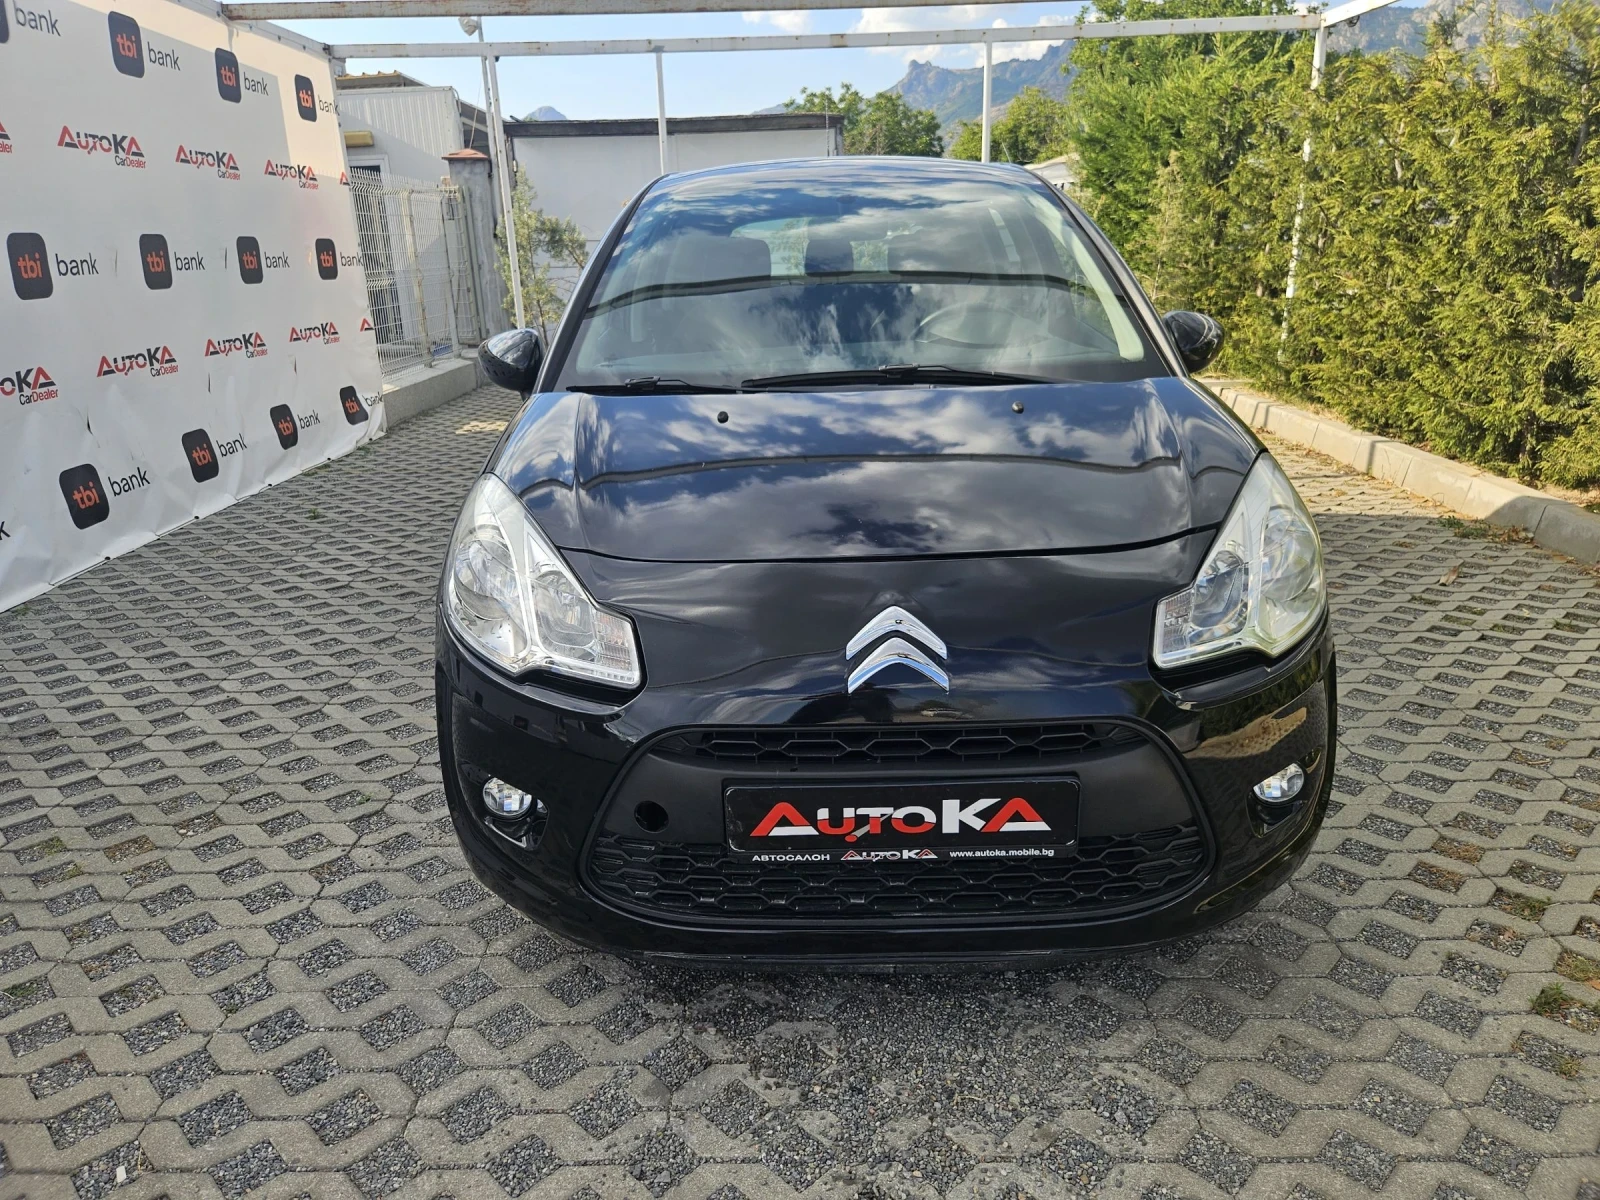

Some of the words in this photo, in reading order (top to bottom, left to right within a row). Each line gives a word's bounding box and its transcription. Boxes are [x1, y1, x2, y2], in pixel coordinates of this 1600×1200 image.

[12, 0, 61, 37] bank
[116, 34, 138, 59] tbi
[147, 41, 181, 71] bank
[220, 65, 236, 87] tbi
[243, 72, 269, 96] bank
[299, 89, 313, 109] tbi
[317, 94, 340, 116] bank
[17, 252, 43, 279] tbi
[55, 252, 99, 277] bank
[146, 251, 166, 273] tbi
[174, 251, 206, 271] bank
[242, 250, 258, 269] tbi
[264, 251, 290, 269] bank
[320, 251, 334, 268] tbi
[340, 252, 364, 267] bank
[345, 396, 360, 414] tbi
[278, 416, 294, 436] tbi
[297, 410, 321, 429] bank
[192, 443, 212, 466] tbi
[72, 481, 100, 510] tbi
[108, 467, 151, 497] bank
[752, 854, 831, 862] АВТОСАЛОН
[949, 848, 1055, 858] www.autoka.mobile.bg
